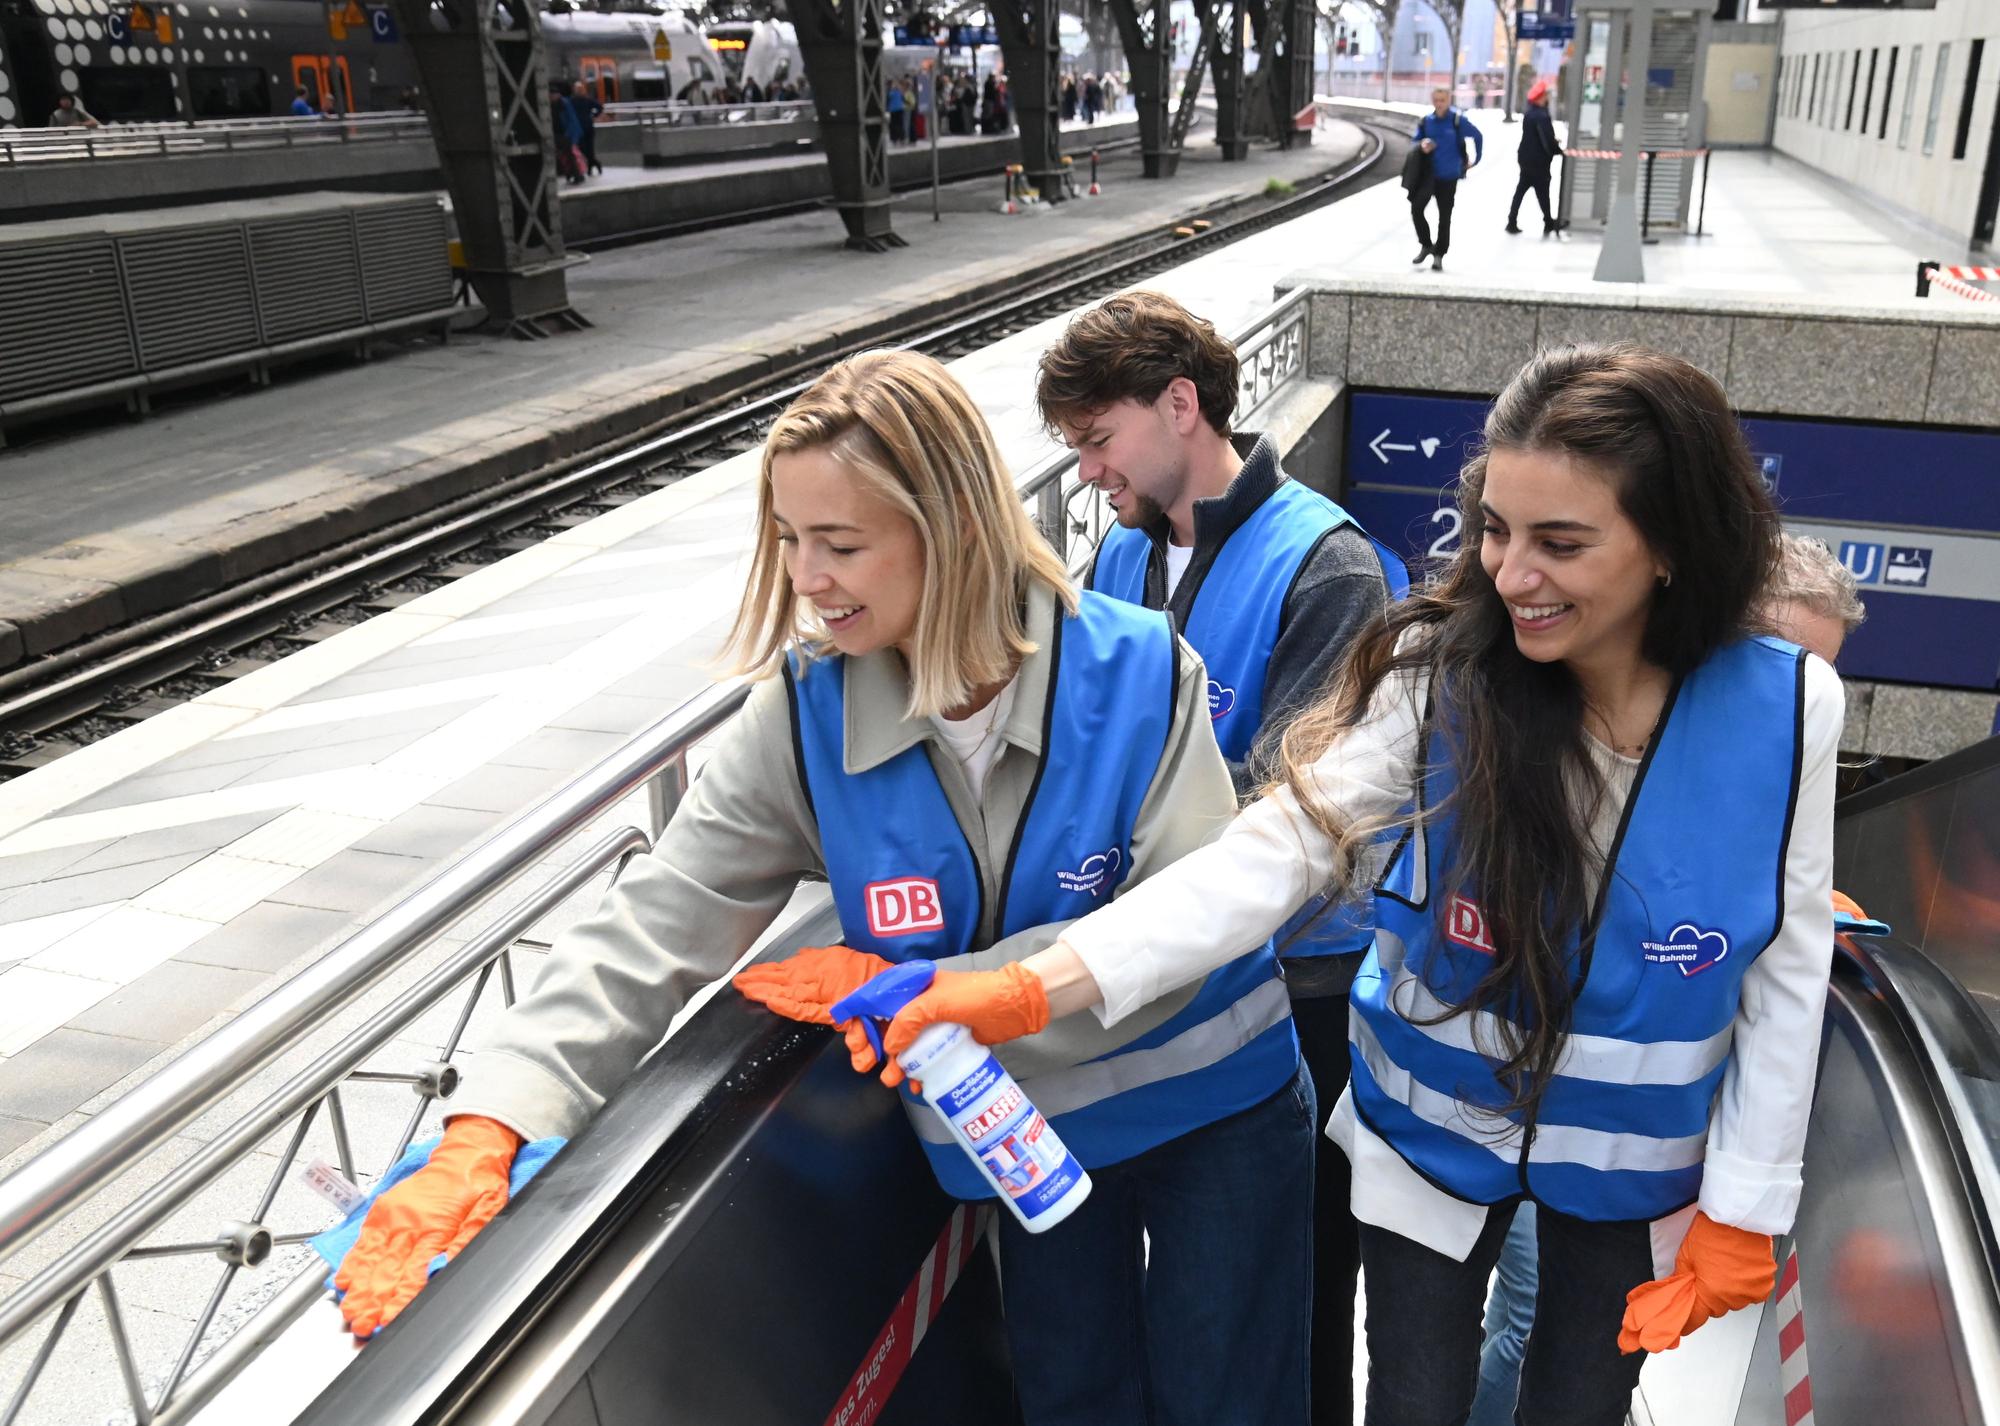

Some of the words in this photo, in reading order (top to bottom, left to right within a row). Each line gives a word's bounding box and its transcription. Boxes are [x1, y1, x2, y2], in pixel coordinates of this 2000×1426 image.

[108, 14, 124, 39] C
[372, 10, 389, 35] C
[1428, 507, 1462, 559] 2
[1844, 544, 1876, 581] U
[875, 885, 938, 927] DB
[1642, 942, 1698, 952] Willkommen
[1660, 953, 1697, 963] Bahnhof
[856, 1323, 896, 1400] Zuges!
